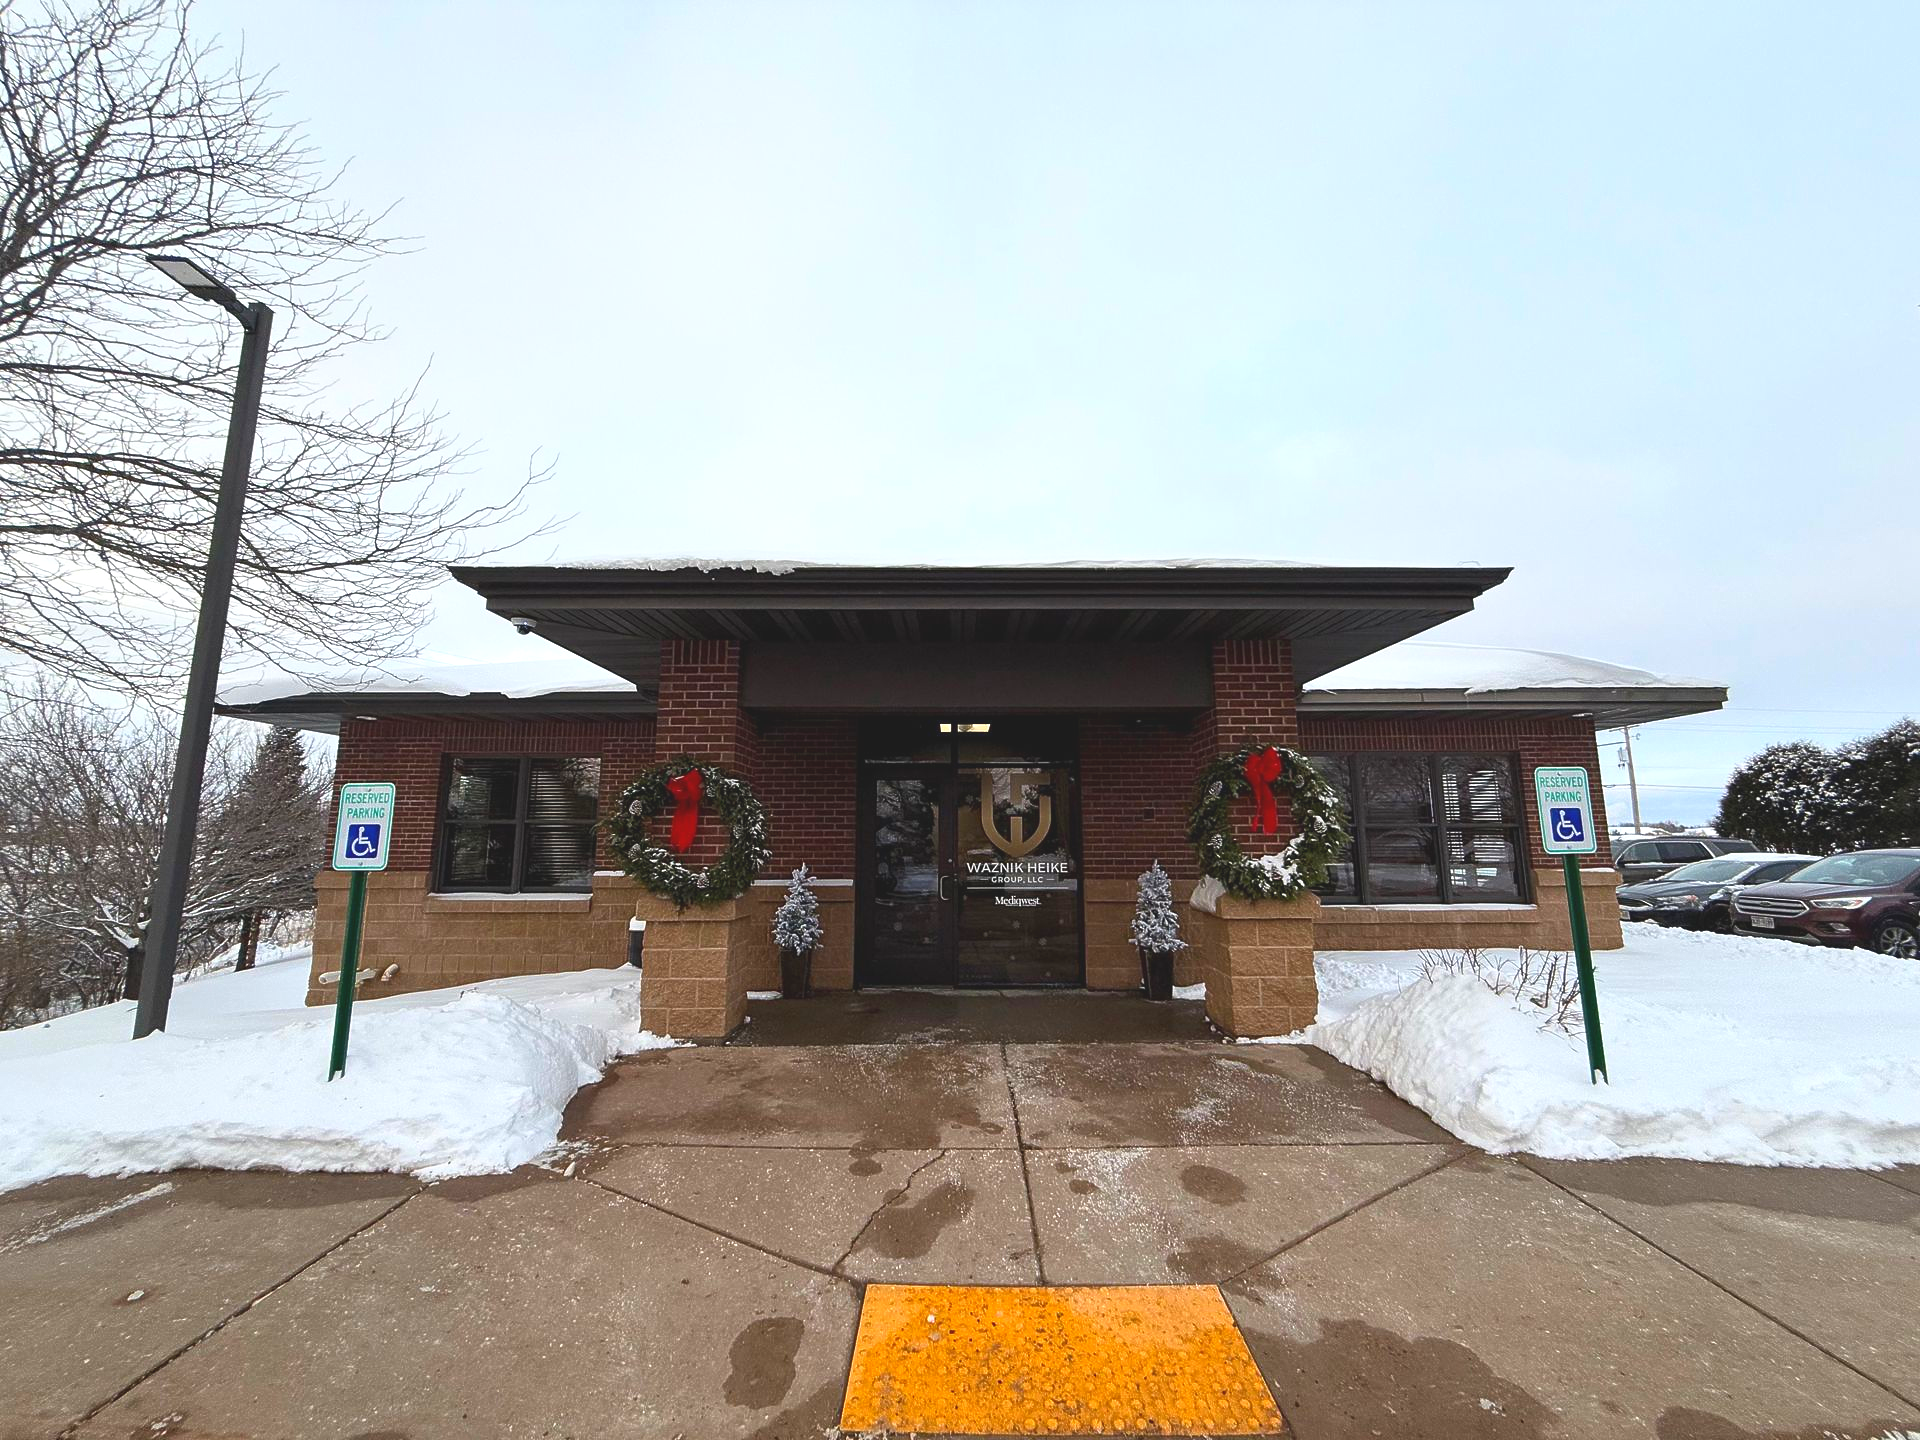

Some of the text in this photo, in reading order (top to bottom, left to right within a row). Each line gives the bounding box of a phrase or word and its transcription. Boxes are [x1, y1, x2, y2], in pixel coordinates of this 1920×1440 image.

[1540, 777, 1583, 787] RESERVED
[345, 792, 390, 803] RESERVED
[1544, 791, 1581, 802] PARKING
[347, 807, 385, 818] PARKING
[966, 863, 1068, 873] WAZNIK HEIKE
[991, 876, 1044, 884] GROUP, LLC
